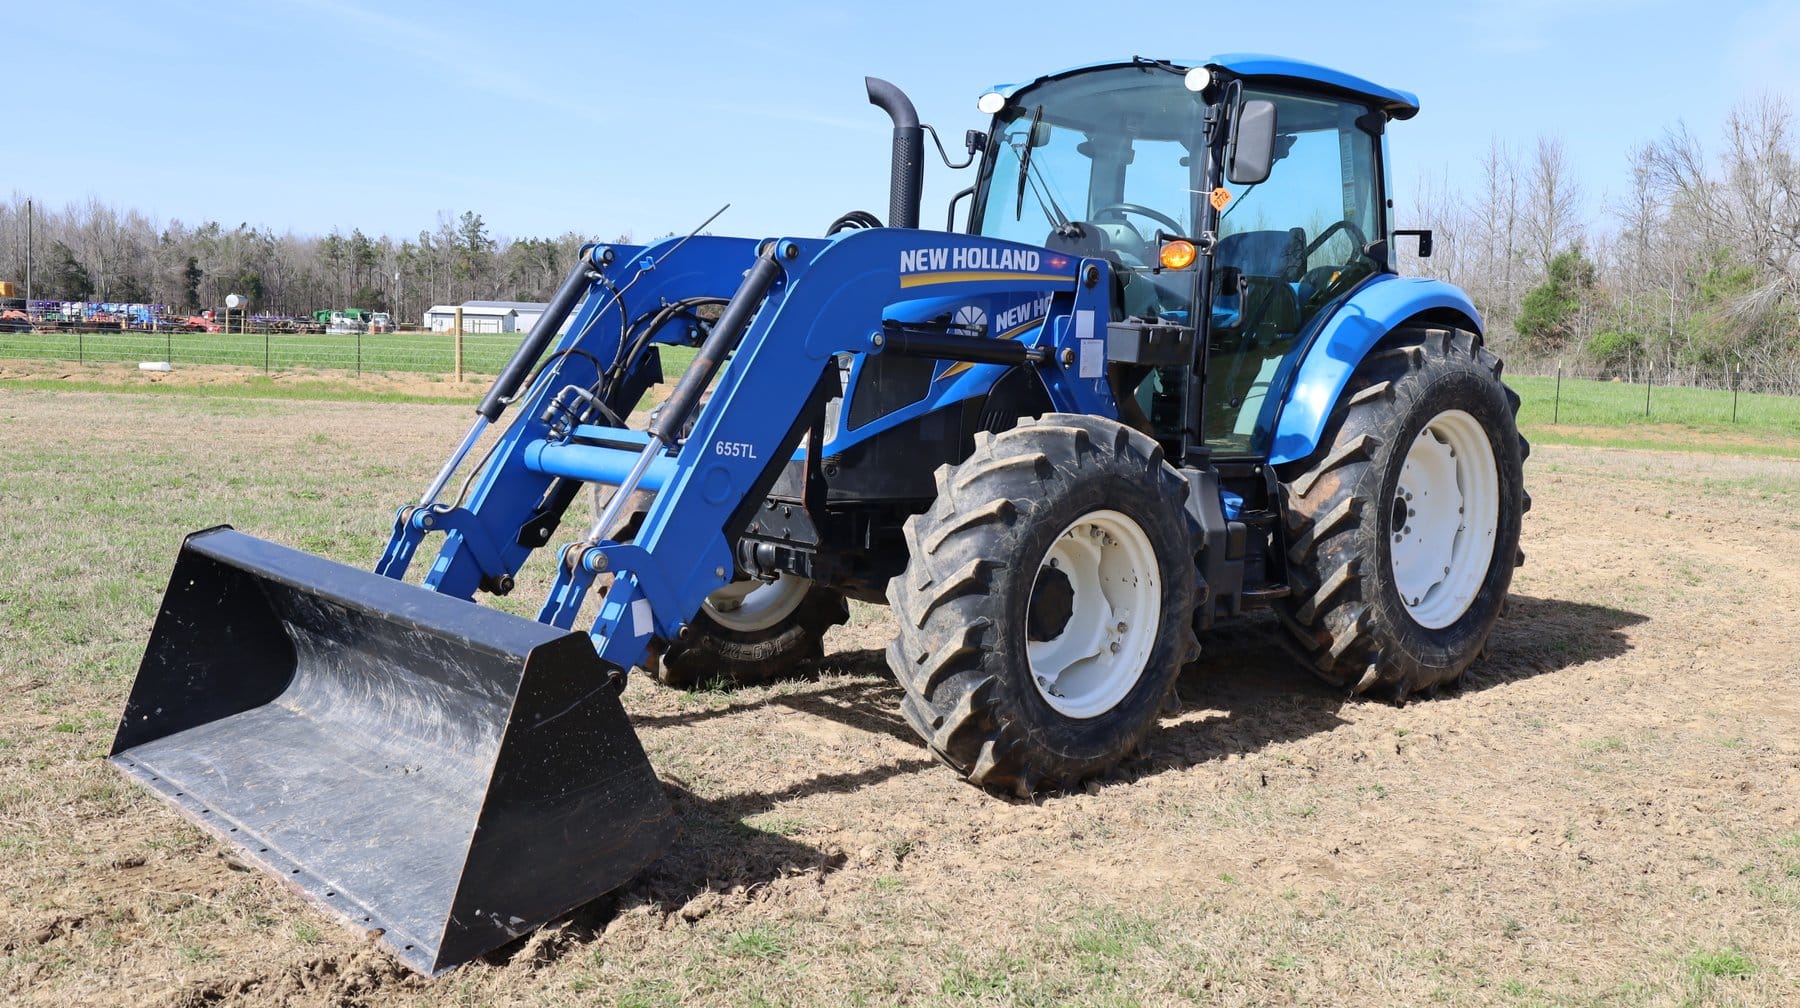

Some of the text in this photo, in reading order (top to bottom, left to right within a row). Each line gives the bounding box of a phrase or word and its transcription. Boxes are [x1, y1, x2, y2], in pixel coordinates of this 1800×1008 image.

[900, 247, 1040, 273] NEW HOLLAND
[996, 302, 1031, 333] NEW
[715, 440, 757, 459] 655TL
